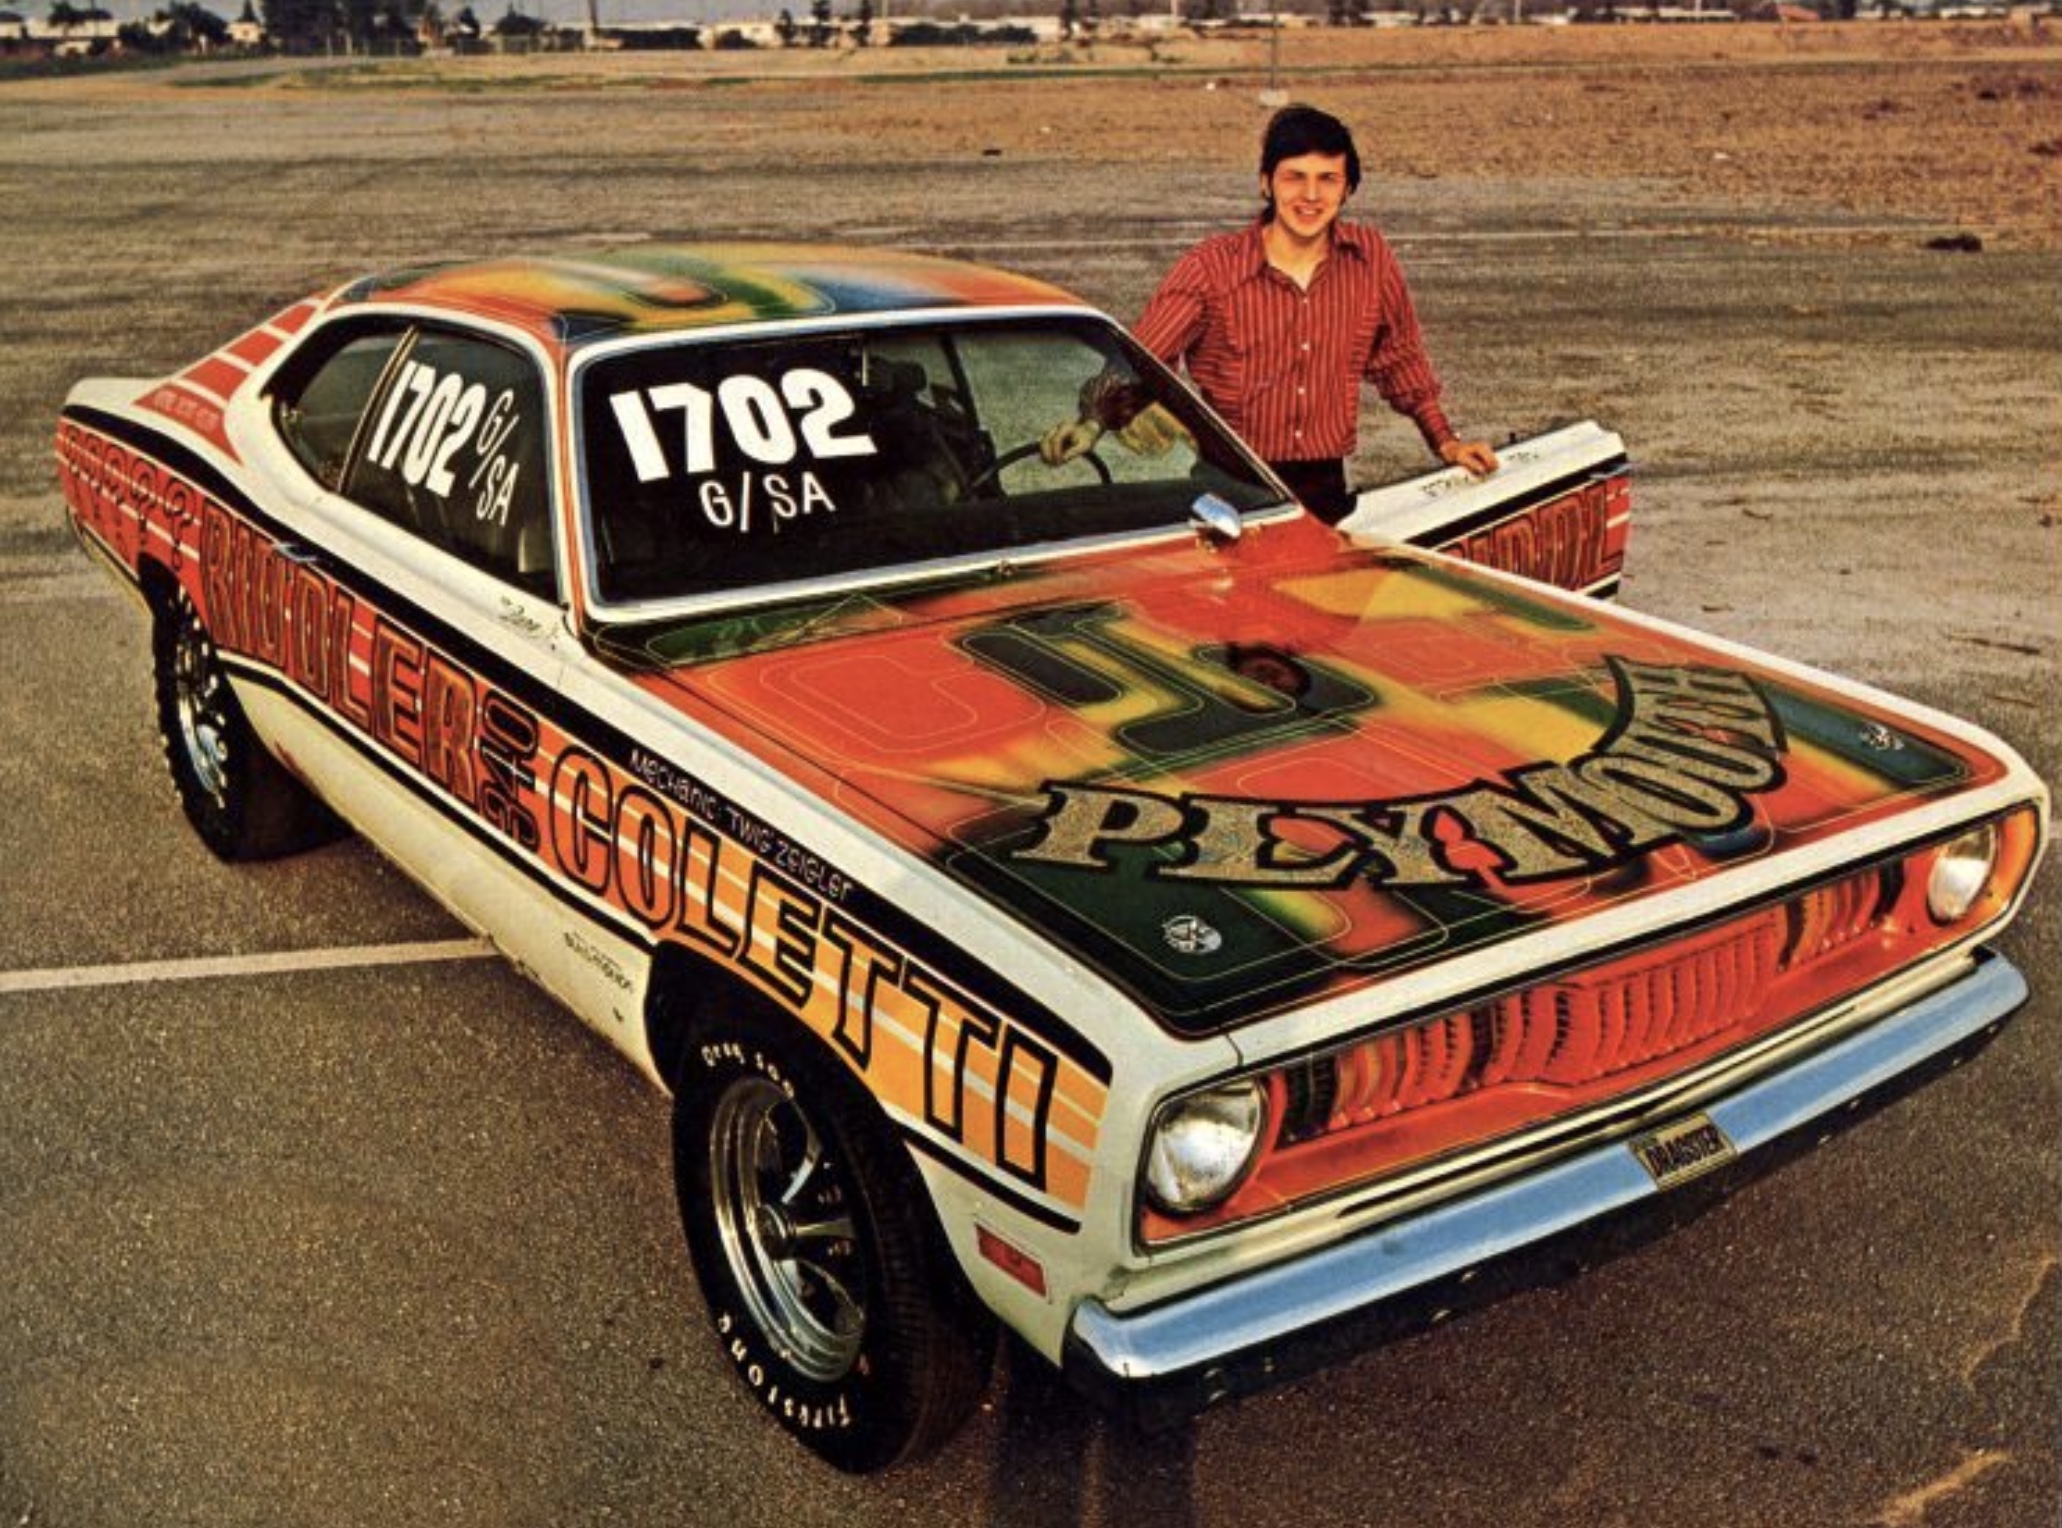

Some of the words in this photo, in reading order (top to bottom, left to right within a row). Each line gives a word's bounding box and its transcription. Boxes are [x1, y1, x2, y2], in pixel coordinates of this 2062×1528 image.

[367, 360, 487, 498] 1702
[609, 368, 878, 482] 1702
[1434, 481, 1624, 592] DDL
[1010, 653, 1790, 890] PLYMOUTH
[203, 496, 478, 807] RIDDLER
[549, 744, 1058, 1192] COLETTI
